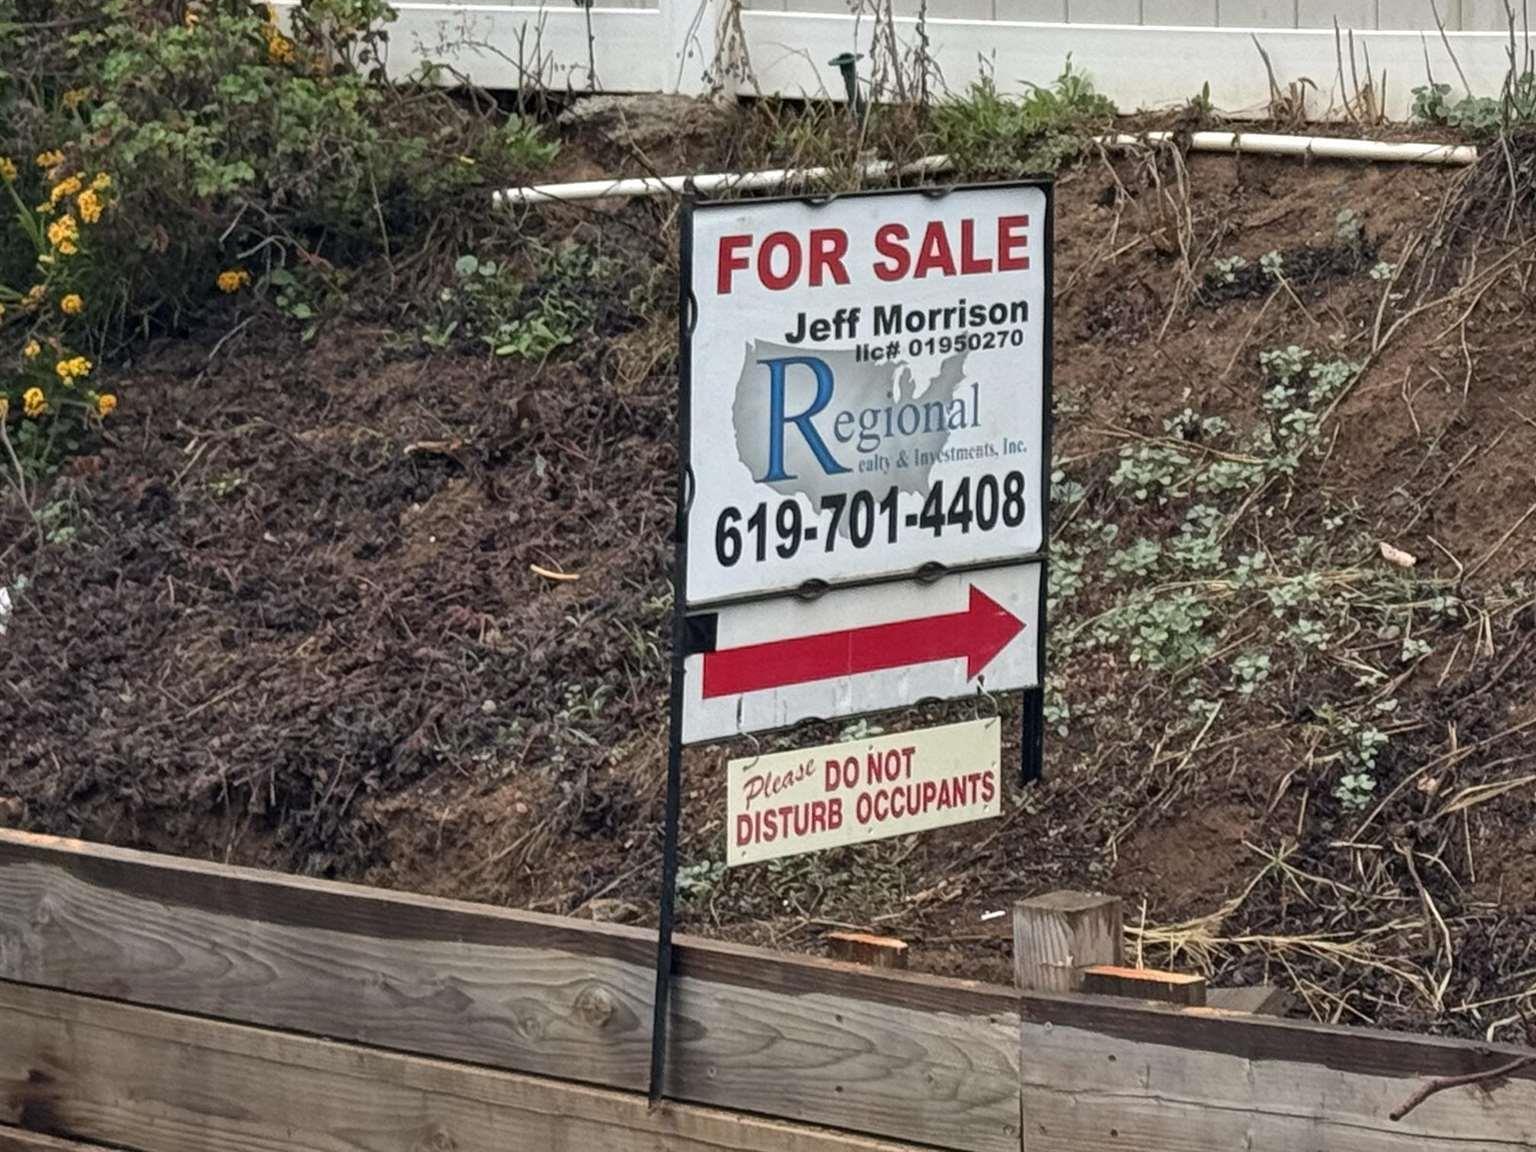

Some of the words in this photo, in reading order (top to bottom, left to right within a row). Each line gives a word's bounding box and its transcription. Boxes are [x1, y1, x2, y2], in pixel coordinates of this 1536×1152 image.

[716, 229, 851, 295] FOR
[873, 214, 1030, 282] SALE
[784, 307, 861, 344] Jeff
[873, 298, 1029, 336] Morrison
[855, 344, 901, 363] lic#
[908, 329, 1024, 357] 01950270
[896, 451, 909, 469] &
[1002, 437, 1028, 455] Inc.
[715, 470, 1026, 568] 619-701-4408
[736, 797, 843, 847] DISTURB
[856, 770, 995, 825] OCCUPANTS
[743, 759, 816, 810] Please
[824, 756, 860, 793] DO
[866, 746, 916, 786] NOT
